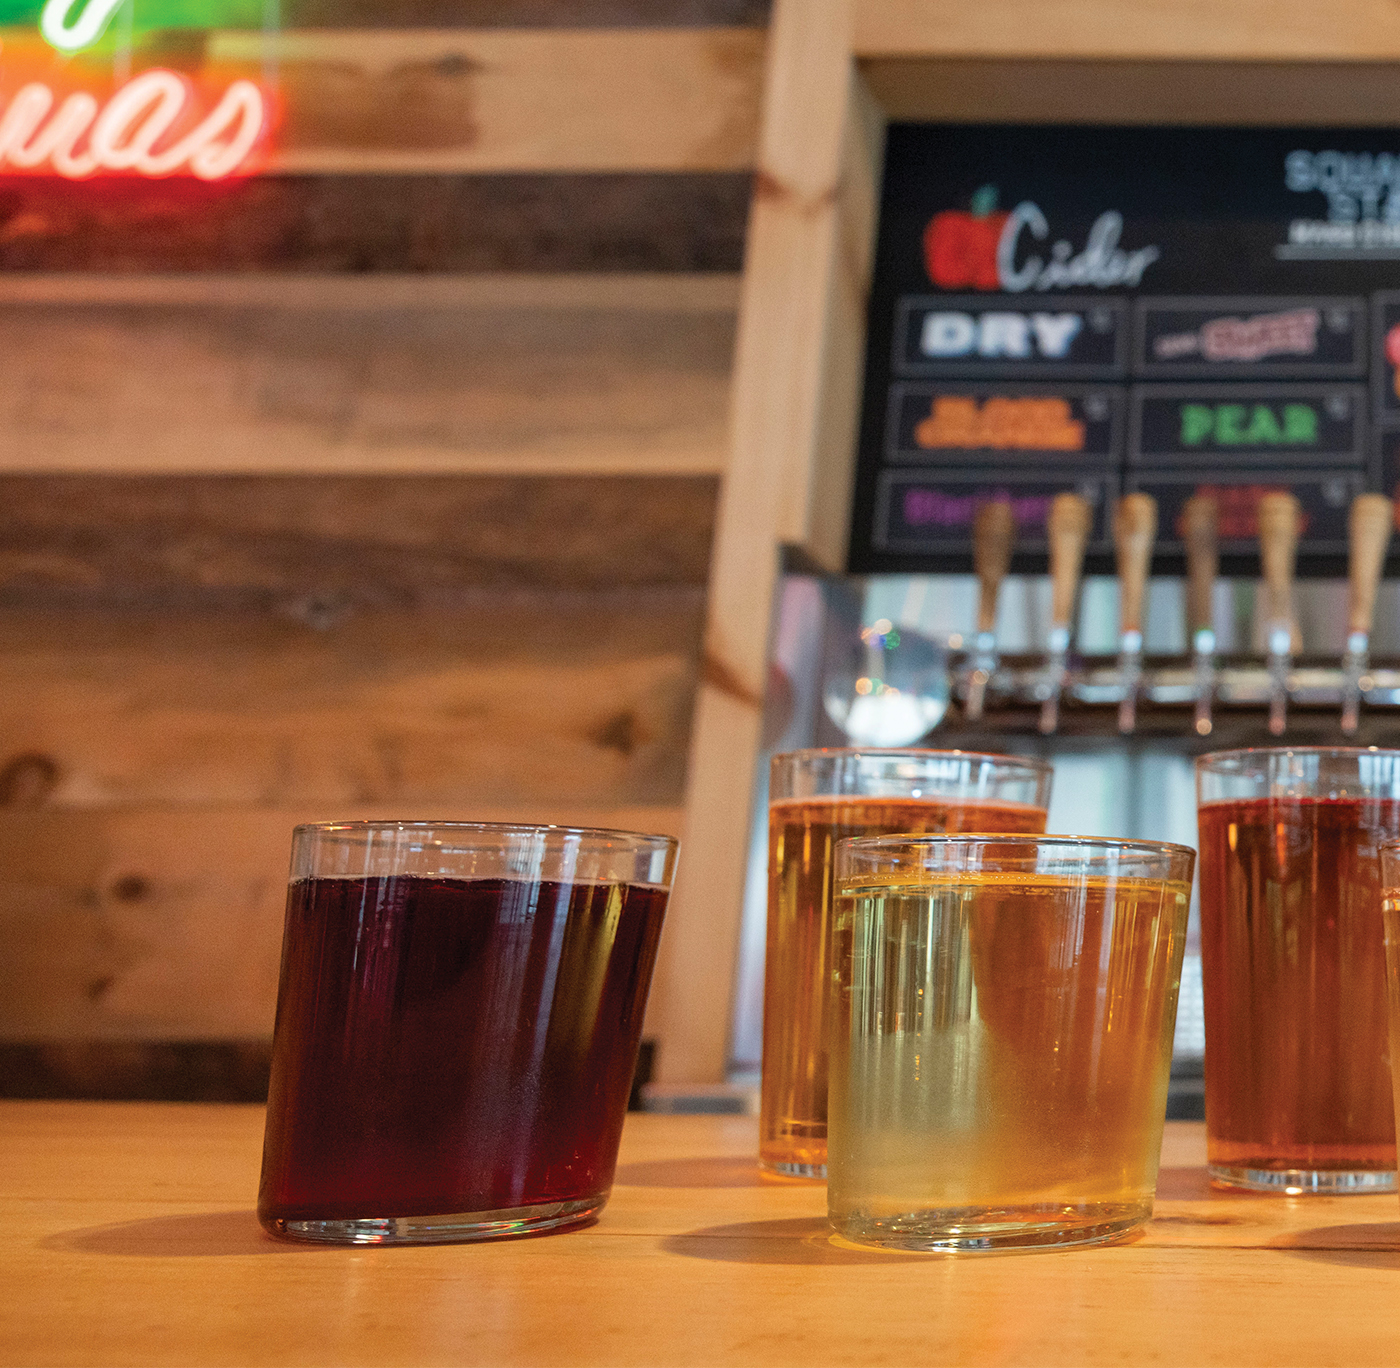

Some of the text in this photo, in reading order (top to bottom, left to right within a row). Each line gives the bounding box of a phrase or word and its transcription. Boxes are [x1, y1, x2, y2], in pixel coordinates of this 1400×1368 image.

[997, 201, 1158, 291] Cider
[920, 311, 1081, 357] DRY
[1181, 403, 1318, 445] PEAR
